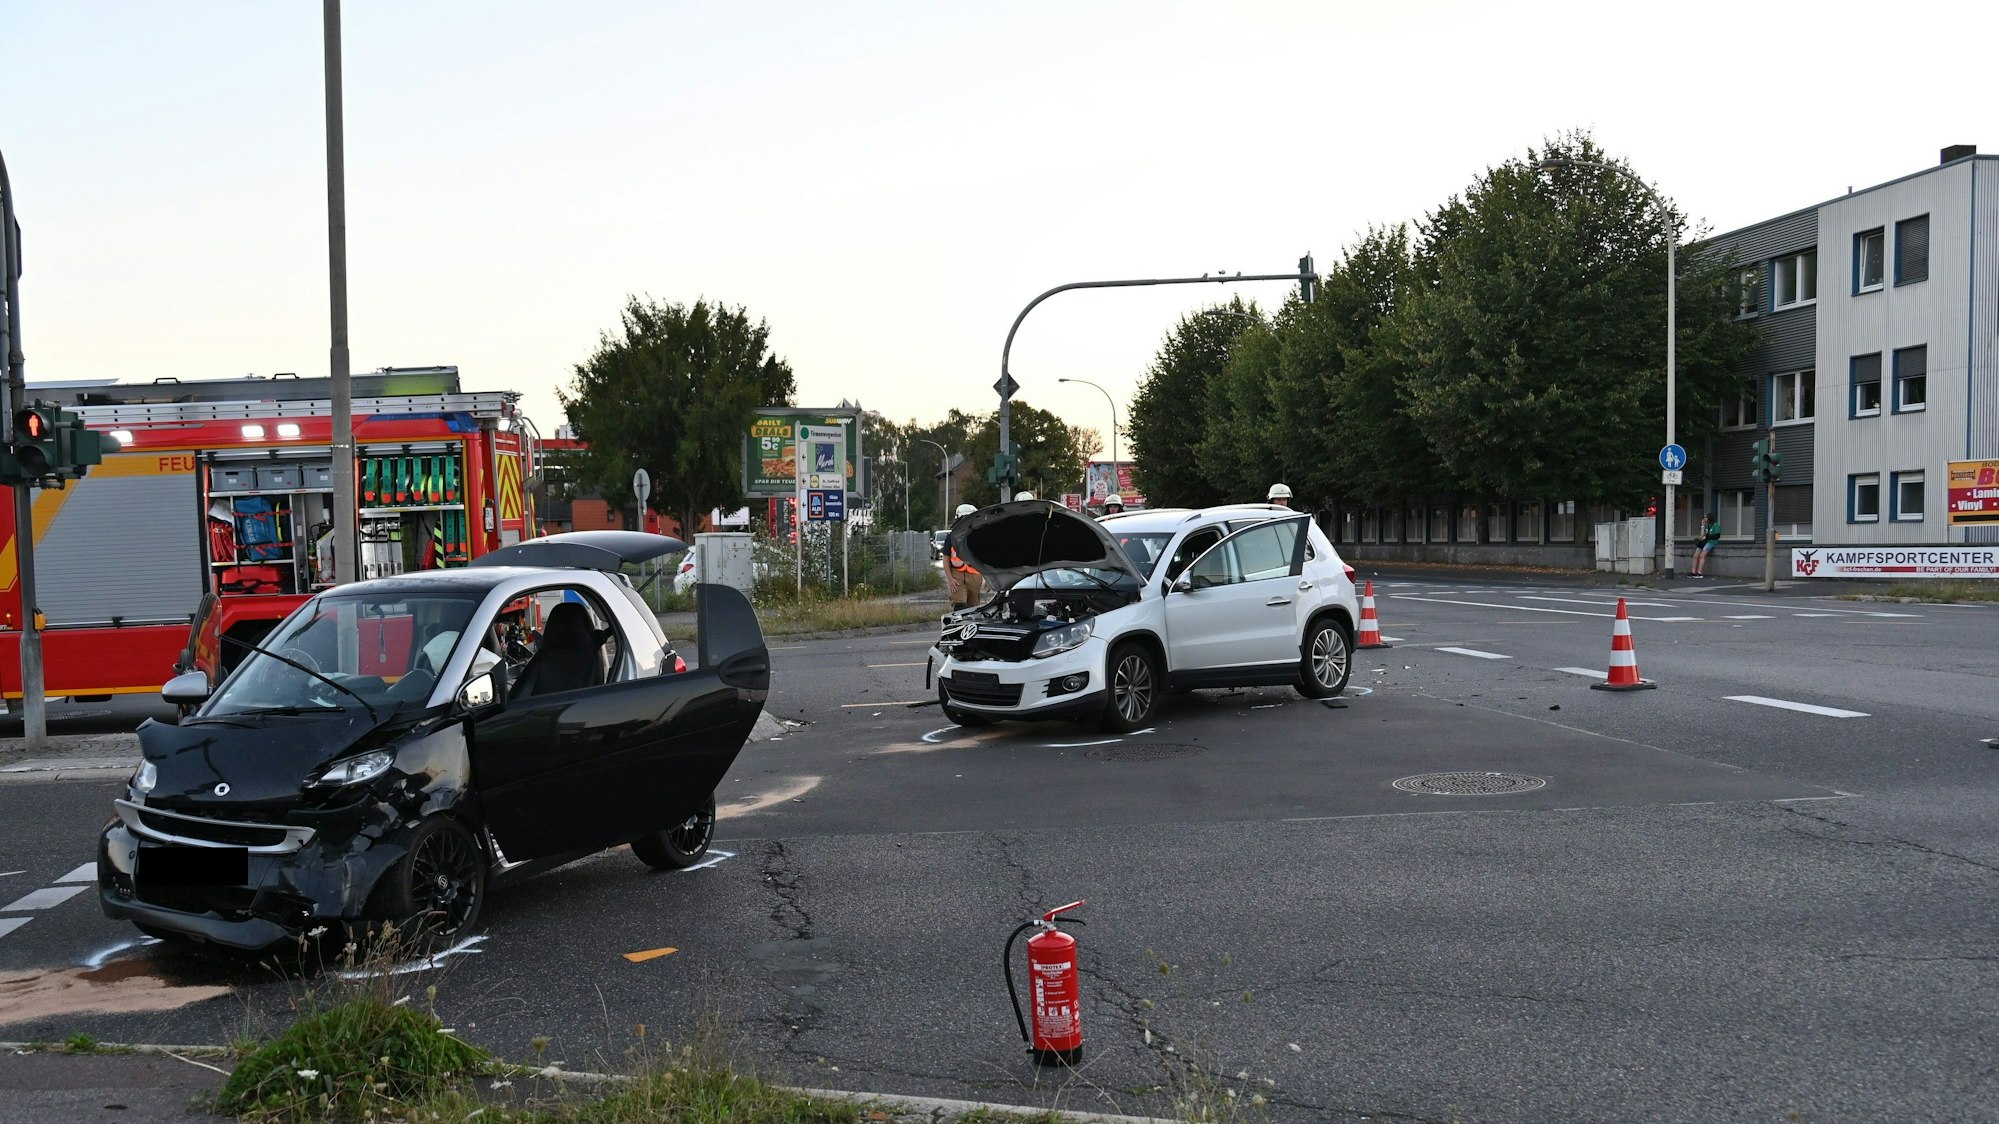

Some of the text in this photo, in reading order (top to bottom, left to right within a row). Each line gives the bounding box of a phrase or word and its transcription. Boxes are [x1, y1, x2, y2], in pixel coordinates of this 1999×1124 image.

[755, 427, 788, 436] DEALS
[159, 456, 195, 472] FEU
[1977, 468, 1999, 485] B
[1958, 500, 1982, 511] Vinyl
[1826, 552, 1994, 564] KAMPFSPORTCENTER
